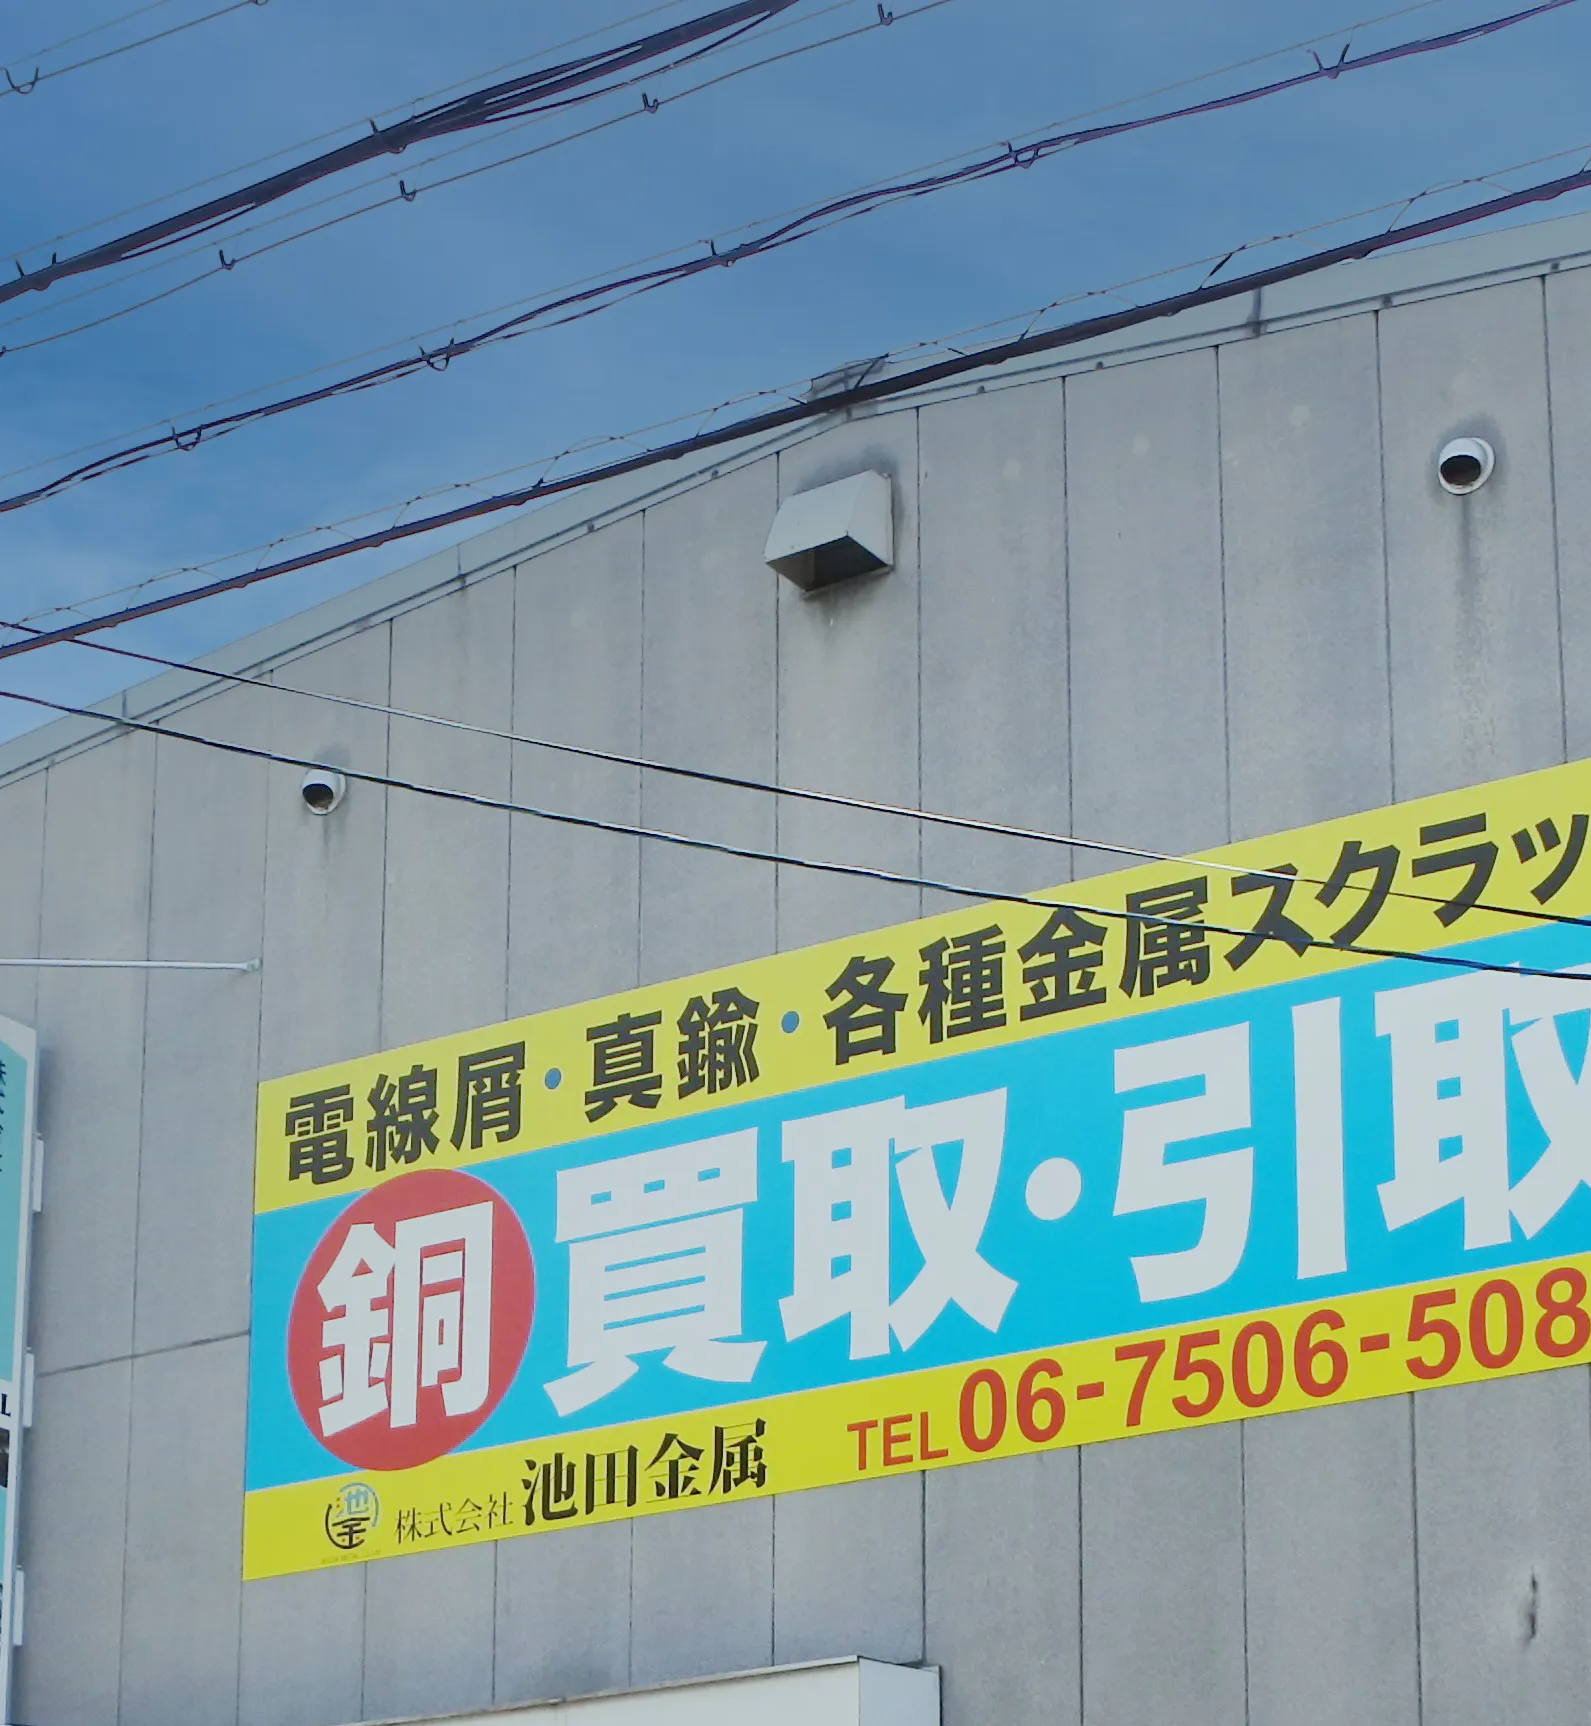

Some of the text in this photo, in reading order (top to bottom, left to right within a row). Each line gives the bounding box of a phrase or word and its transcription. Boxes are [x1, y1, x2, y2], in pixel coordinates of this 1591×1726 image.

[316, 1200, 494, 1440] 銅
[392, 1417, 768, 1546] 株式会社 池田金属
[847, 1411, 948, 1475] TEL
